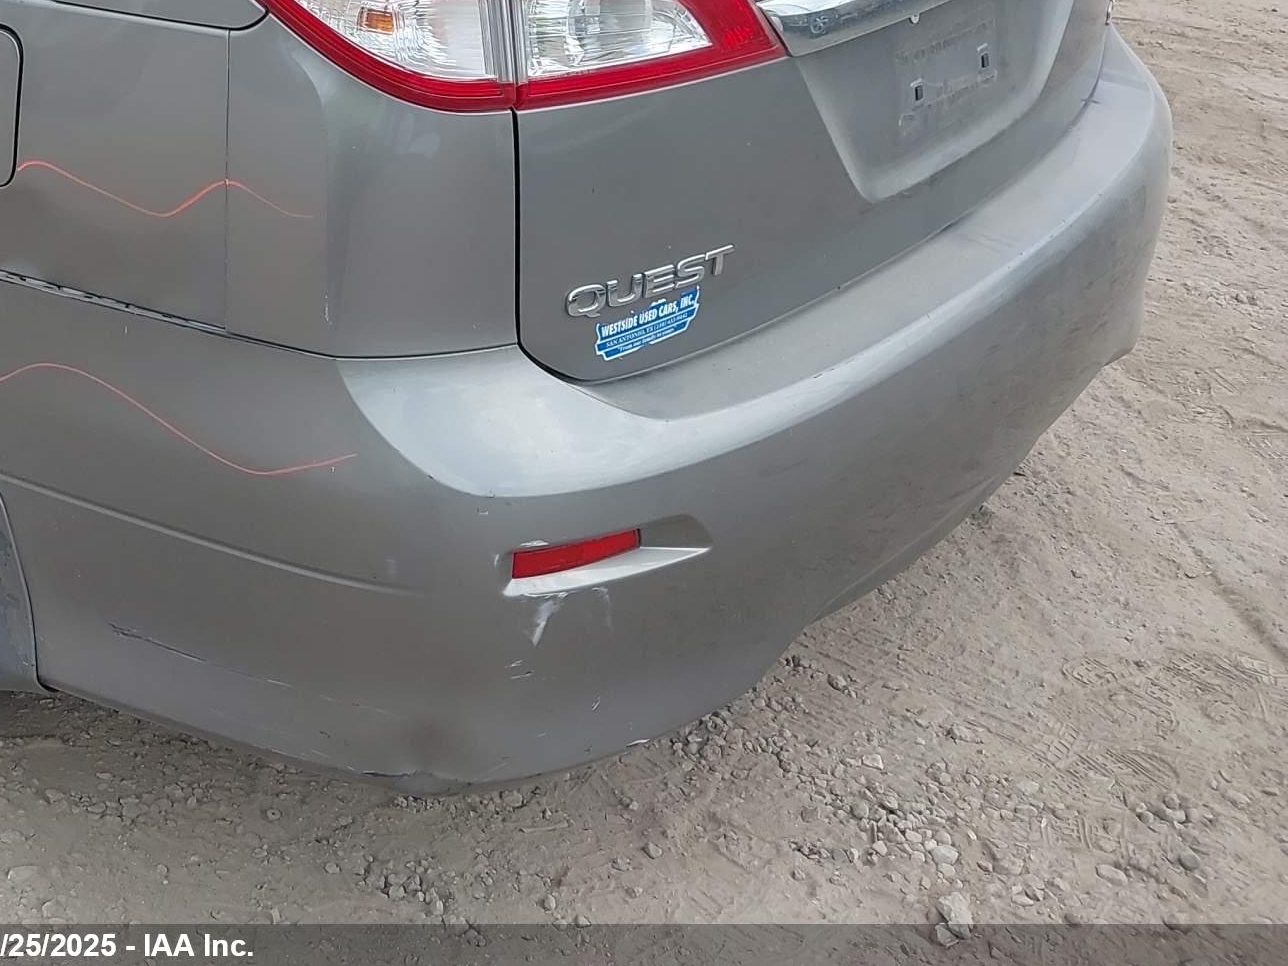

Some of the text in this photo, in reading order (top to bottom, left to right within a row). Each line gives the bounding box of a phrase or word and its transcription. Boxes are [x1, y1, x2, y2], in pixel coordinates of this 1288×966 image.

[566, 243, 735, 318] QUEST
[602, 294, 695, 337] WESTSIDE USED CARS, INC.
[606, 338, 619, 348] SAN
